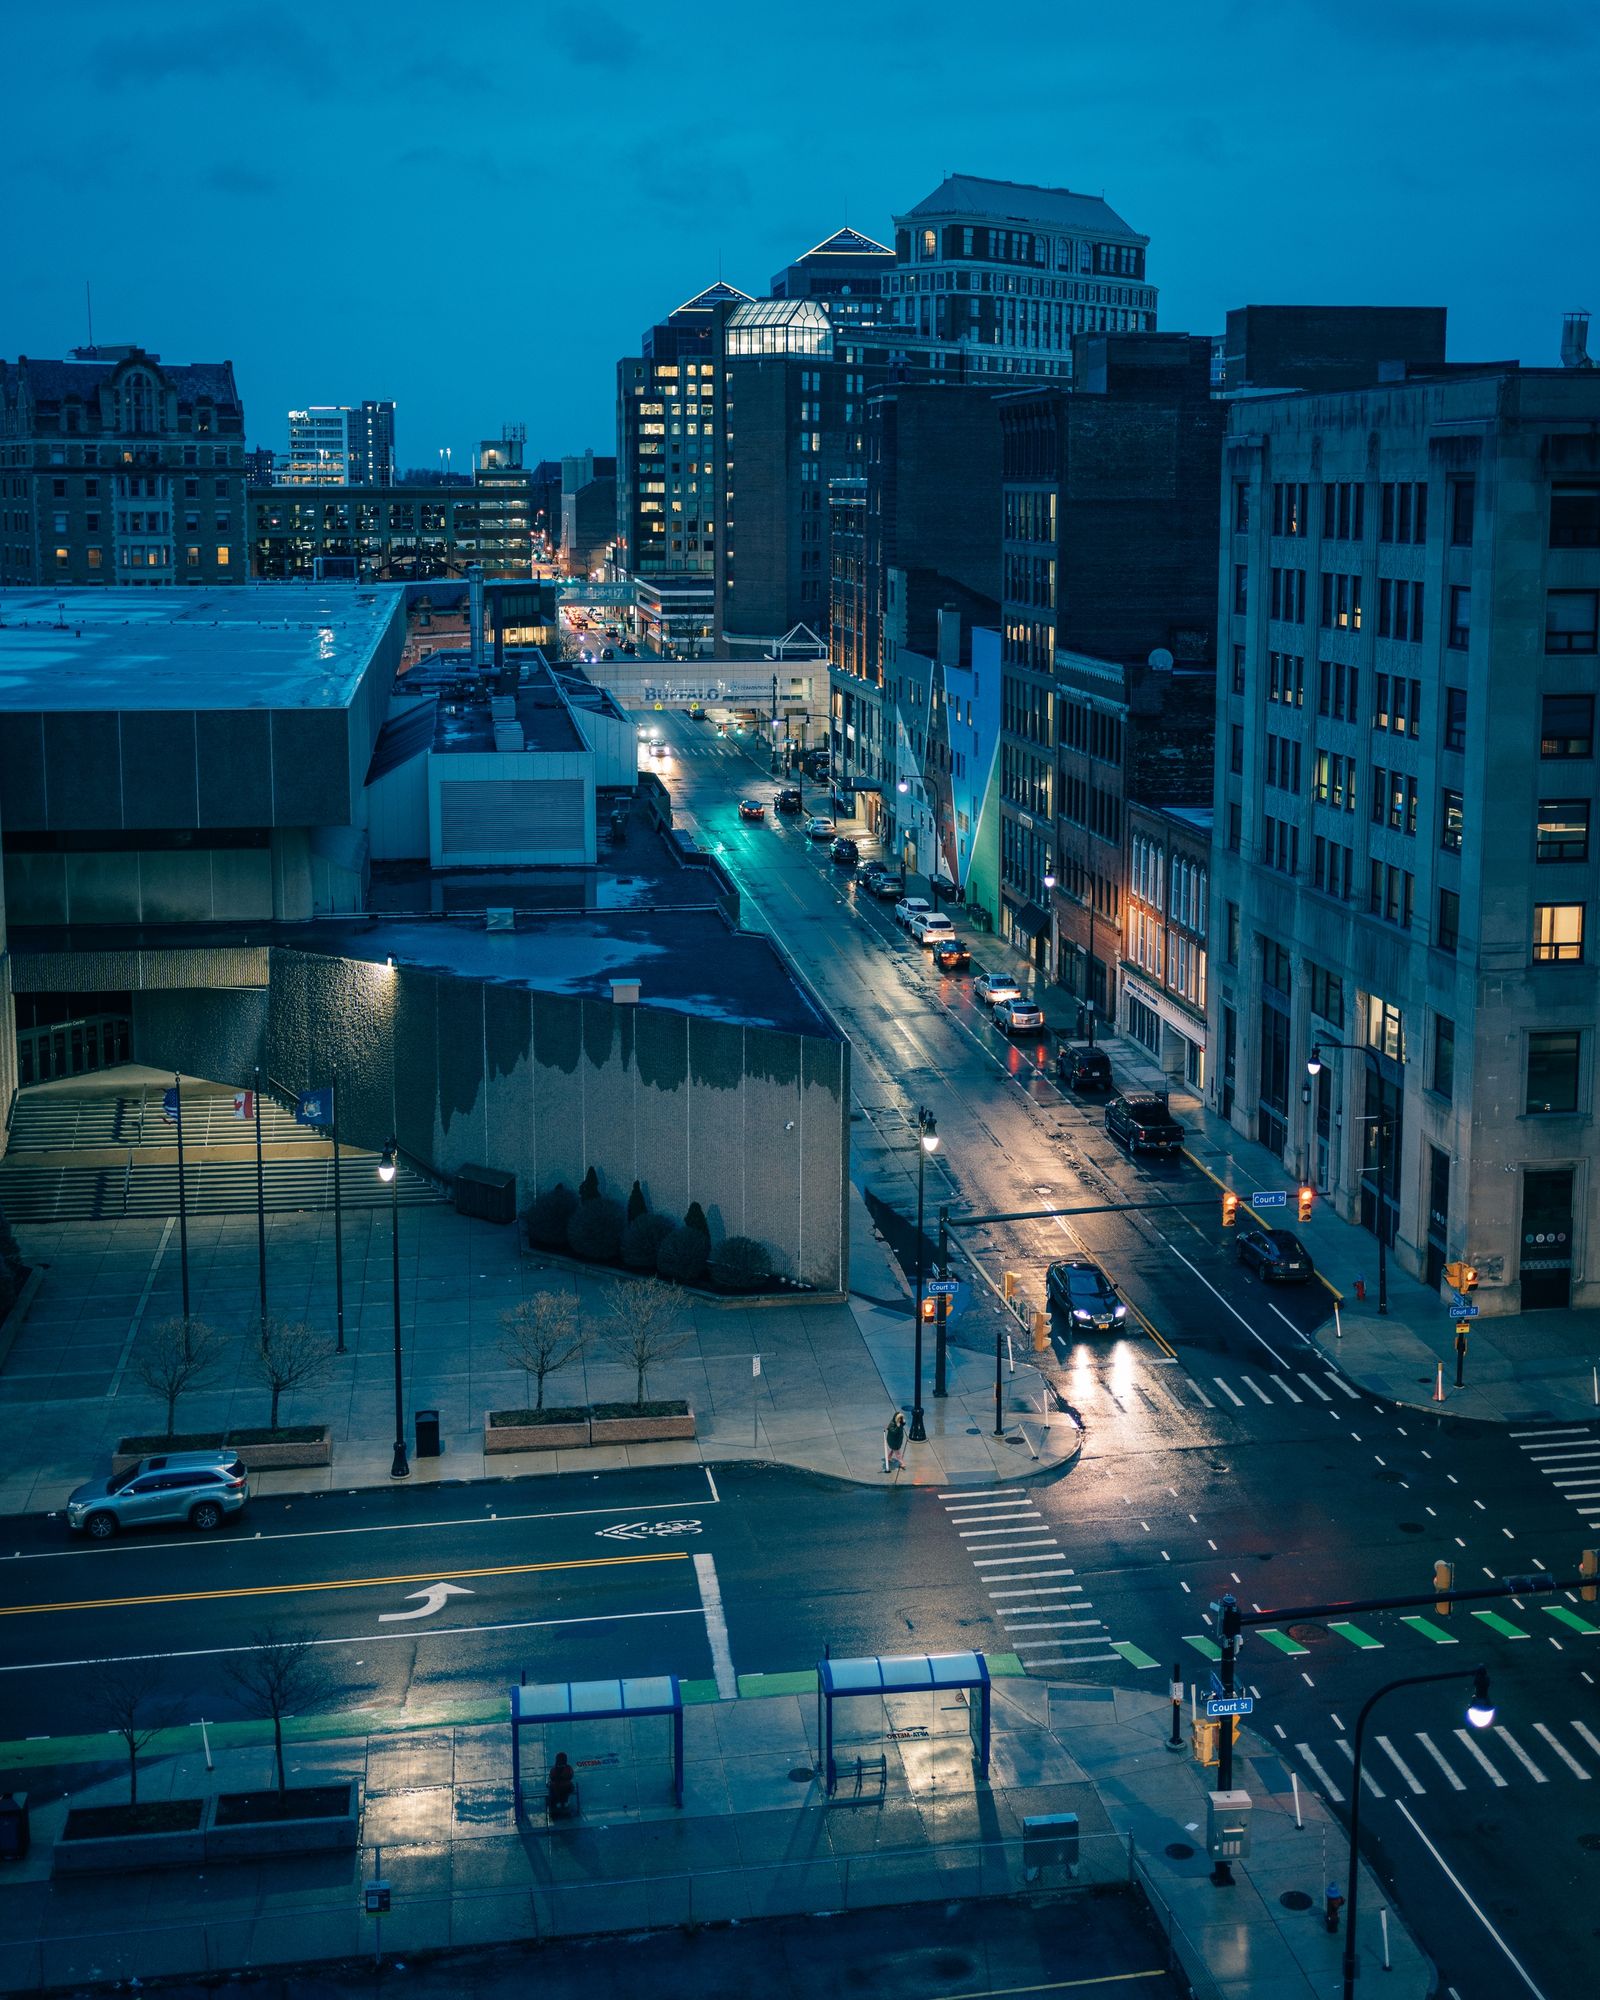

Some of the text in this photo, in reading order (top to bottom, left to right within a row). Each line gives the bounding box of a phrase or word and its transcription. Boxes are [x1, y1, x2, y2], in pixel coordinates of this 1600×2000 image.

[645, 687, 720, 701] BUFFALO
[1254, 1195, 1275, 1204] Court
[1212, 1702, 1248, 1712] Court St
